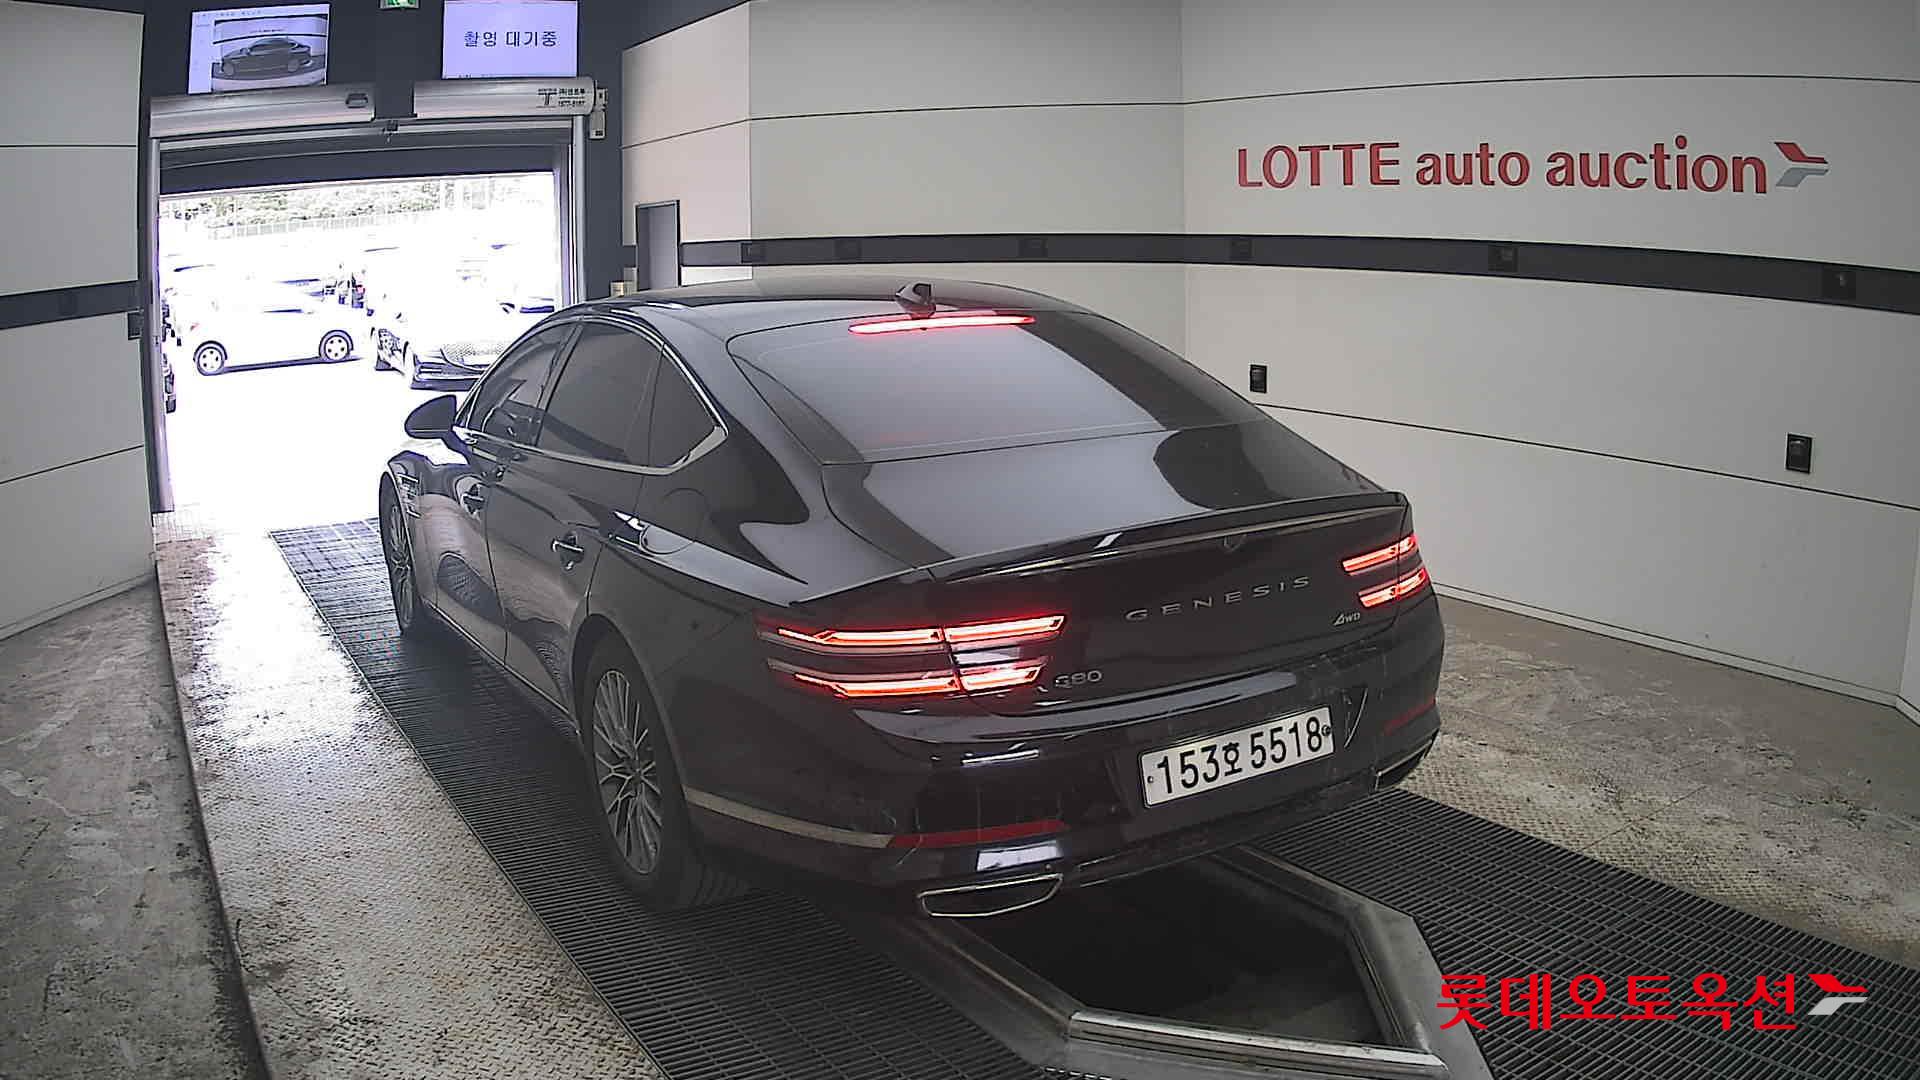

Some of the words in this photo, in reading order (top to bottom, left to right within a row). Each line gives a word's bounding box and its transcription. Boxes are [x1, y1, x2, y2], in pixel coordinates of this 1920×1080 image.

[464, 31, 497, 47] 촬영
[505, 31, 557, 47] 대기중
[1238, 142, 1400, 188] LOTTE
[1416, 143, 1530, 186] auto
[1546, 135, 1767, 194] auction
[1125, 576, 1310, 621] GENESIS
[1055, 670, 1102, 688] G80
[1157, 742, 1242, 794] 153호
[1250, 716, 1322, 769] 5518
